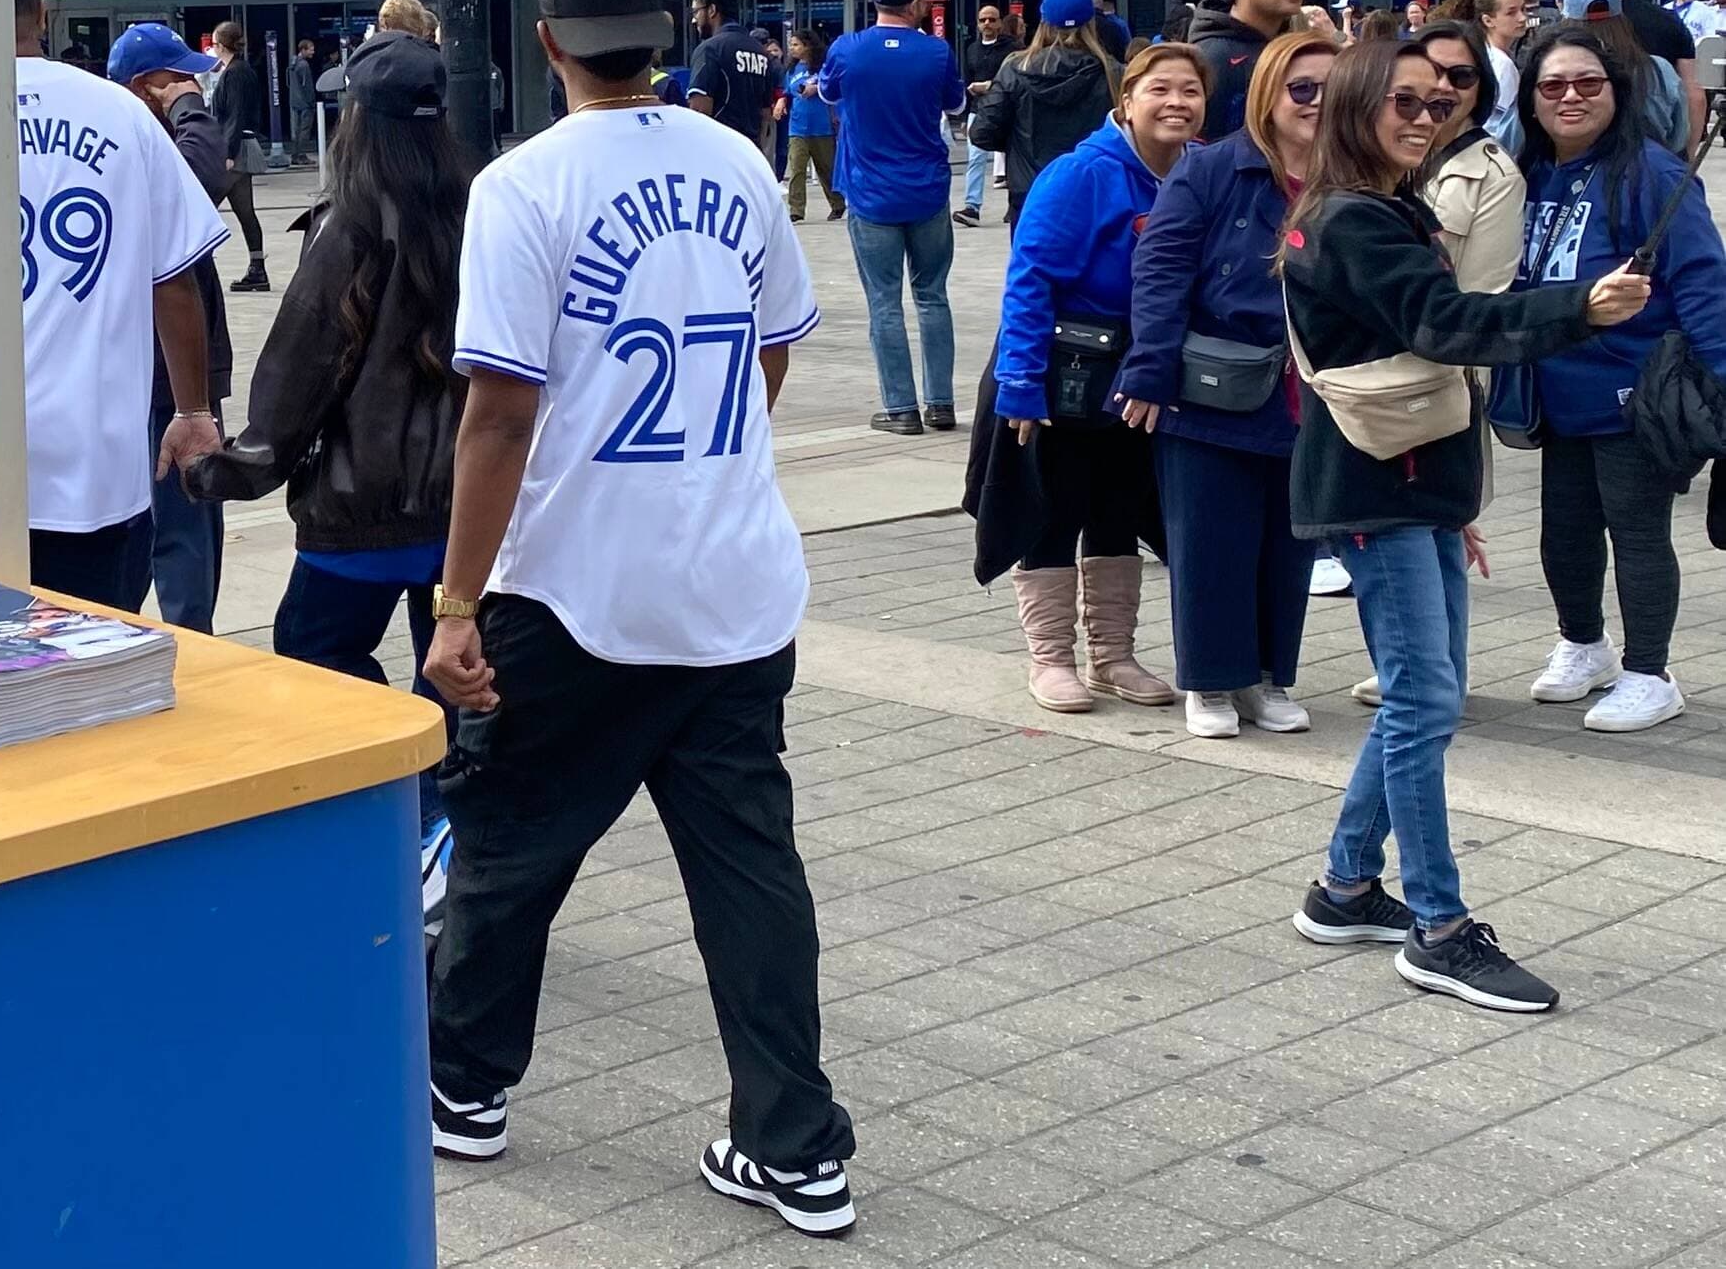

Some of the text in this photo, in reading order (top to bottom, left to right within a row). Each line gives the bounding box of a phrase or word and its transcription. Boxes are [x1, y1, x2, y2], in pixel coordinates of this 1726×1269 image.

[19, 118, 120, 176] AVAGE
[562, 174, 748, 326] GUERRERO
[592, 311, 756, 463] 27
